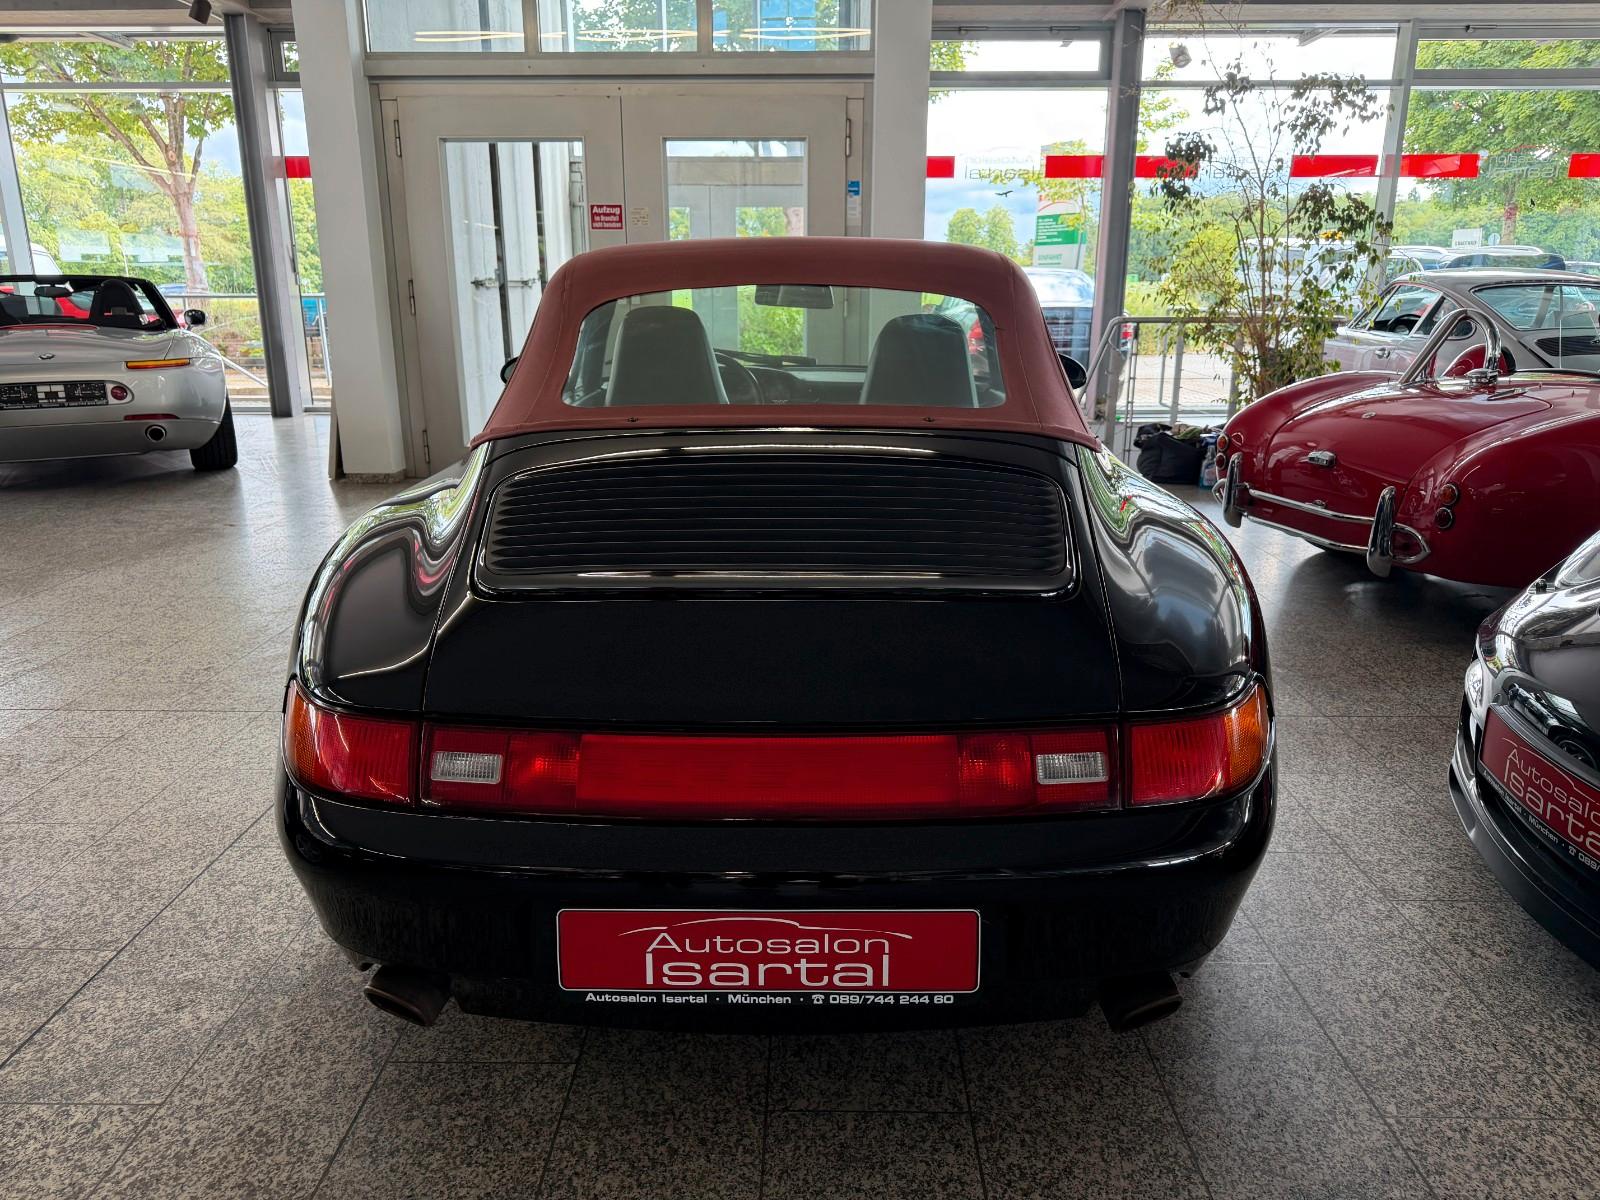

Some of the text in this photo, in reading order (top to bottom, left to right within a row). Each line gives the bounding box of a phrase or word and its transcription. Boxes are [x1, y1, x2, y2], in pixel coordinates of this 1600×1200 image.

[592, 206, 620, 215] Aufzug
[1528, 814, 1560, 844] München
[646, 932, 890, 954] Autosalon
[645, 953, 890, 987] Isartal
[585, 992, 954, 1005] Autosalon Isartal München 089/744 244 60
